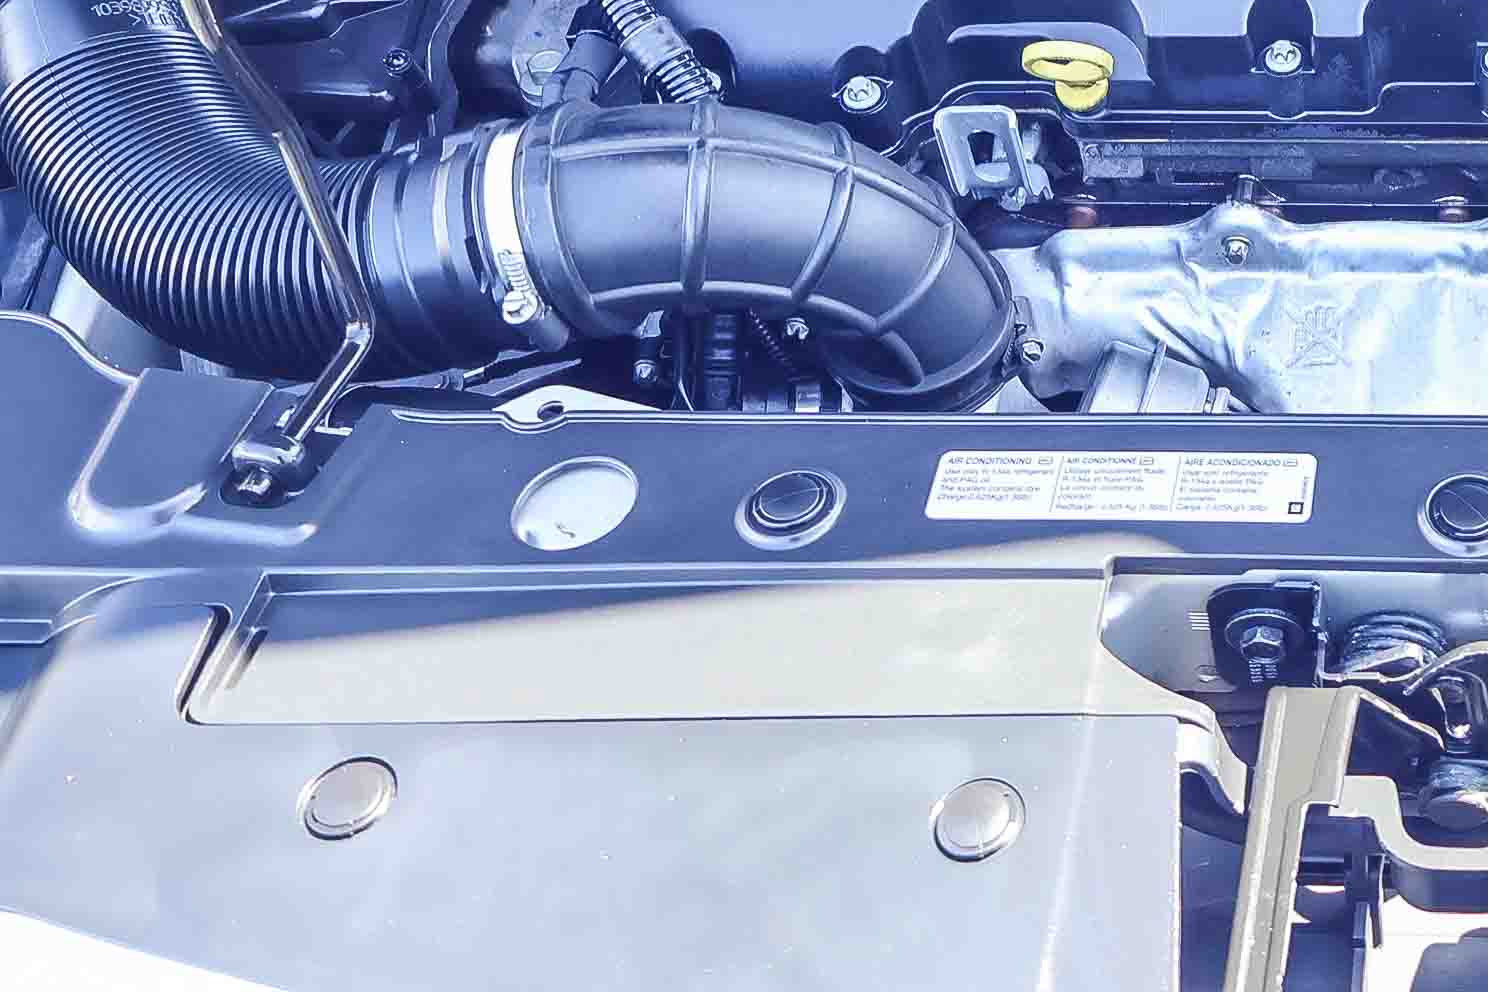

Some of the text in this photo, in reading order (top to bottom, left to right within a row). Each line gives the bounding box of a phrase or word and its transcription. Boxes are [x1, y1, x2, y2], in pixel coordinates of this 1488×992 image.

[947, 457, 1033, 465] AIR CONDITIONING
[1184, 457, 1282, 467] AIRE ACONDICIONADO
